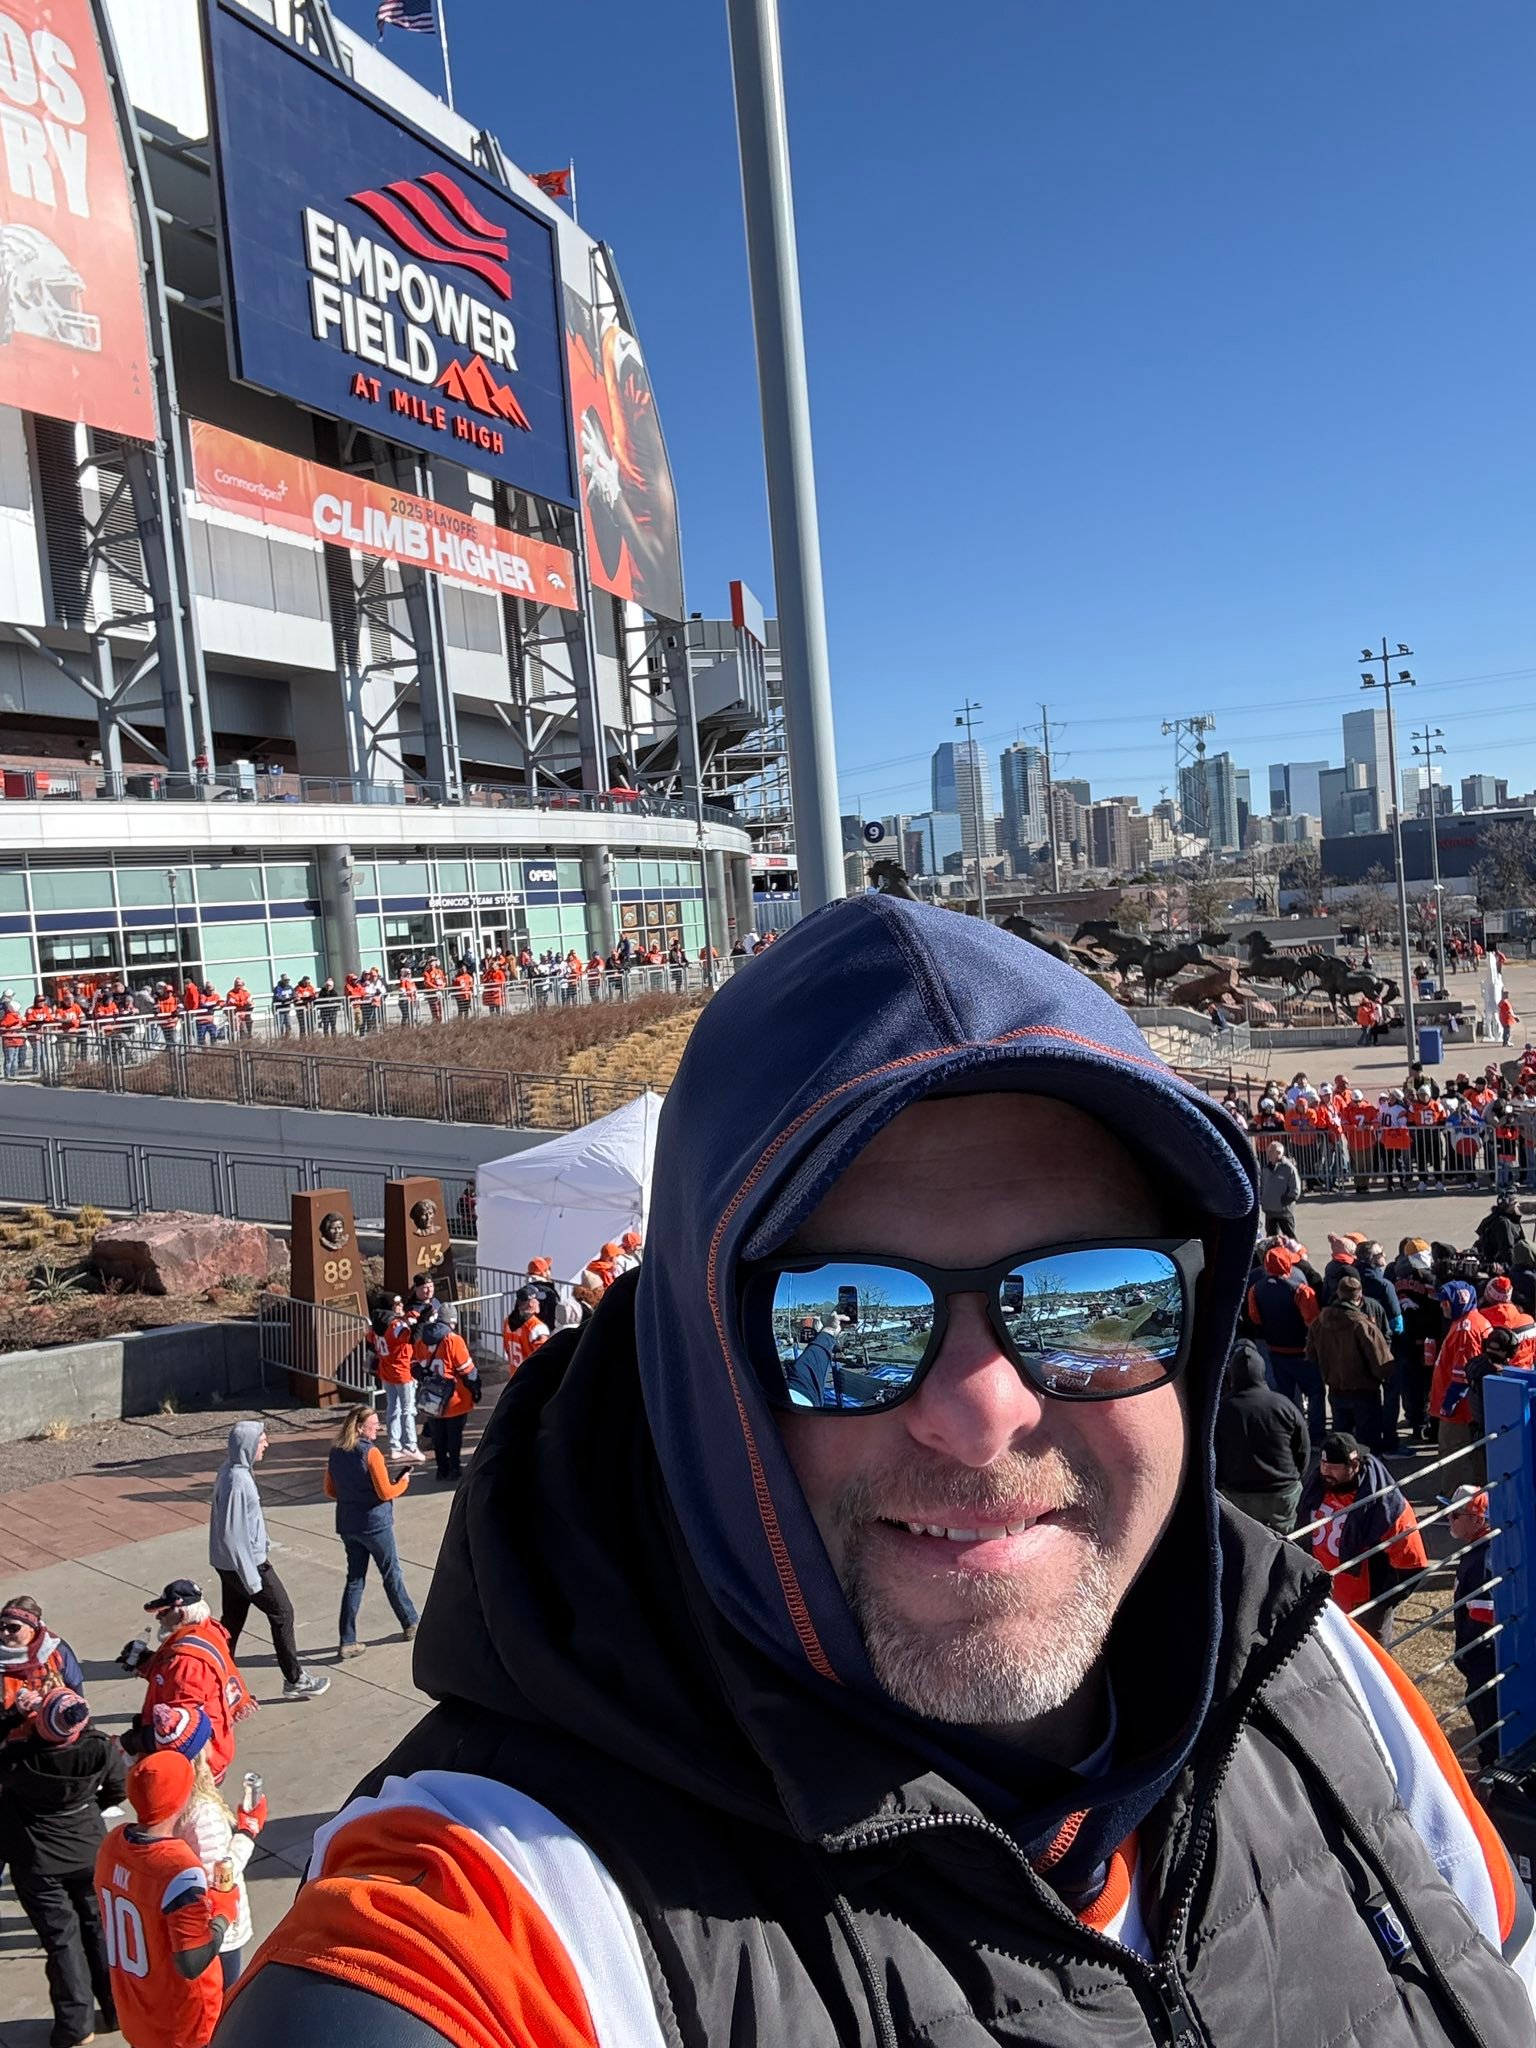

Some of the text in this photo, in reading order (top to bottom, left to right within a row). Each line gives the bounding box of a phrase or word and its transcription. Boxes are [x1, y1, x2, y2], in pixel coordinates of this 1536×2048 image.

[304, 207, 518, 371] EMPOWER
[312, 276, 438, 384] FIELD
[353, 373, 504, 454] AT MILE HIGH
[390, 497, 478, 539] 2025 PLAYOFFS
[313, 494, 536, 594] CLIMB HIGHER
[869, 826, 880, 839] 9
[529, 869, 557, 882] OPEN
[428, 895, 520, 908] BRONCOS TEAM STORE
[1419, 1110, 1434, 1126] 15
[416, 1243, 444, 1269] 43
[324, 1258, 352, 1284] 88
[508, 1340, 525, 1368] 15
[112, 1863, 131, 1892] NIX
[101, 1886, 149, 1979] 10
